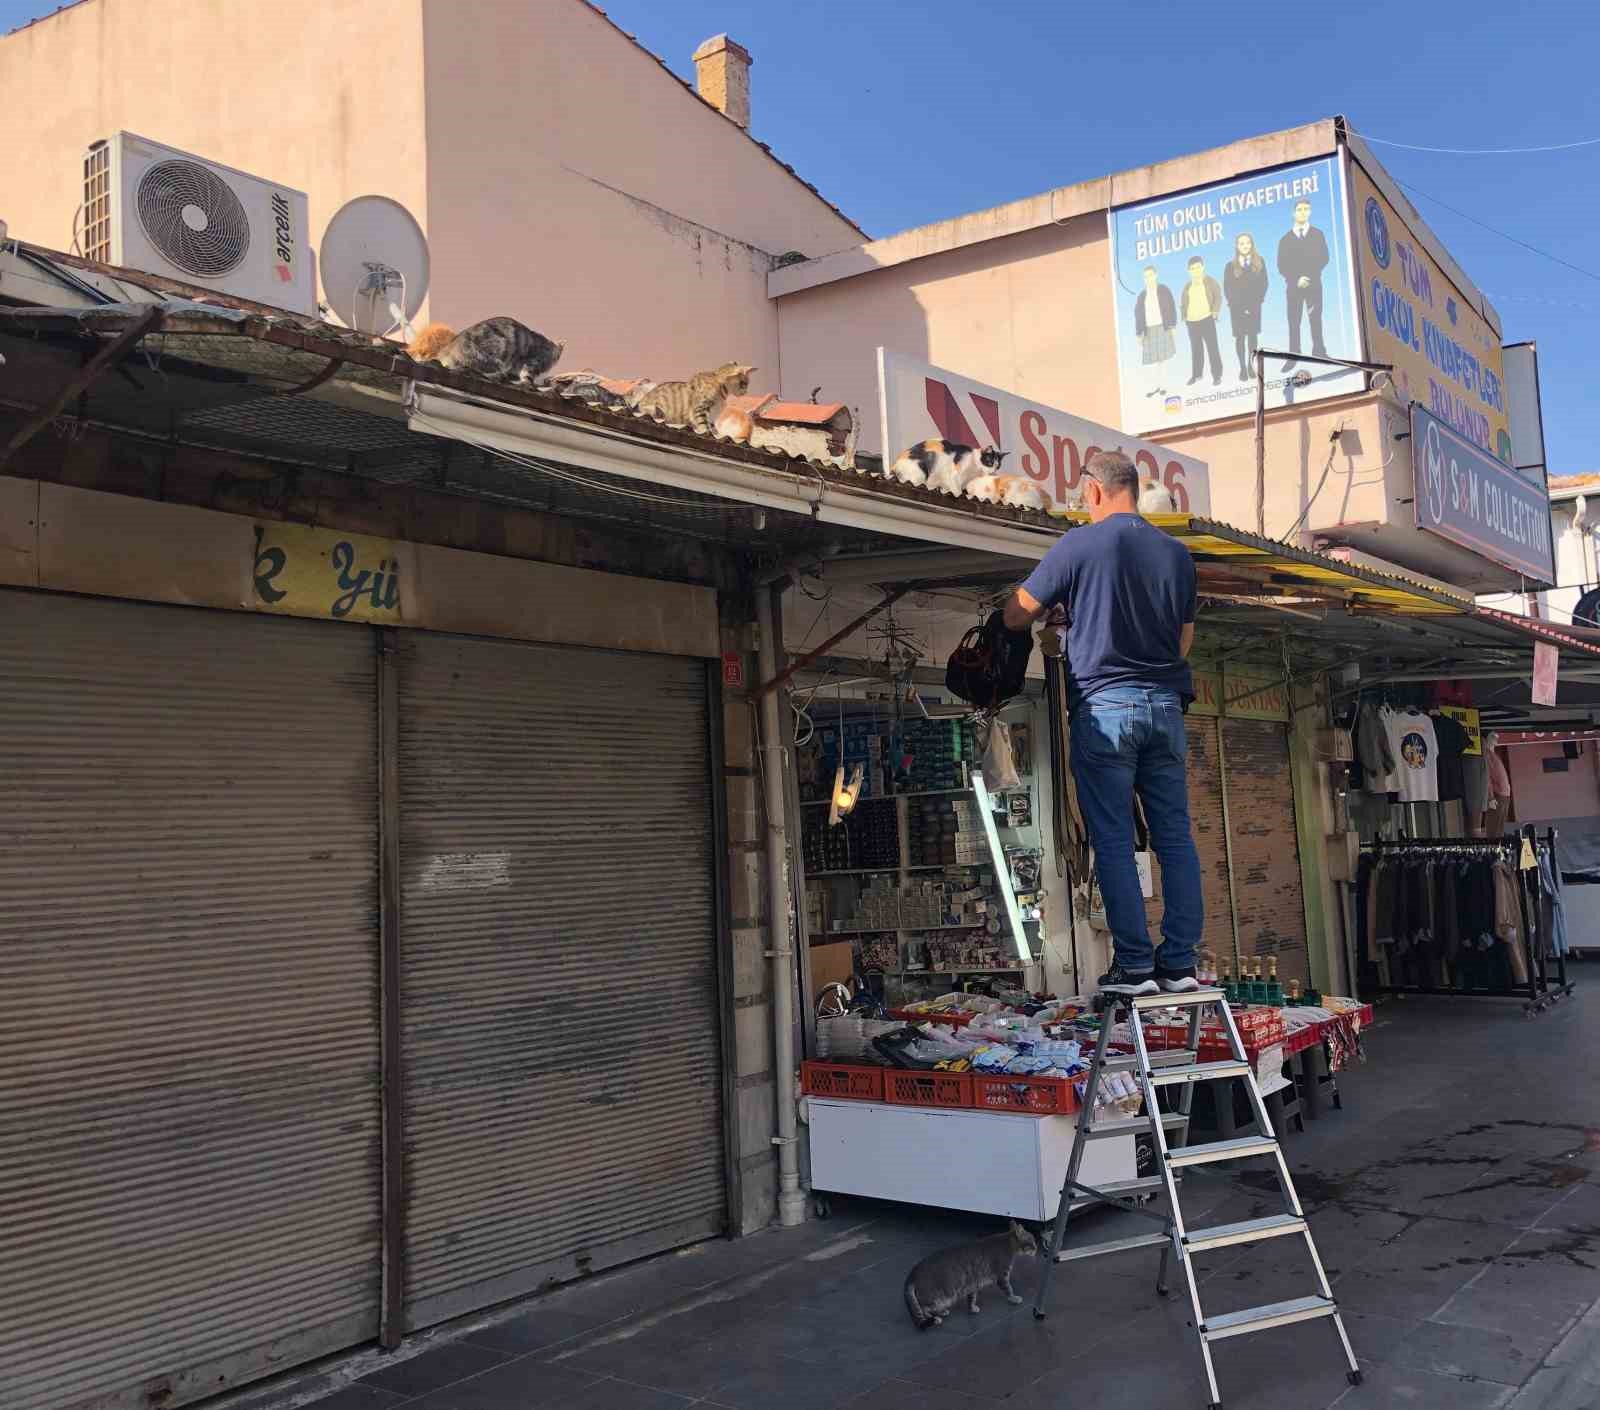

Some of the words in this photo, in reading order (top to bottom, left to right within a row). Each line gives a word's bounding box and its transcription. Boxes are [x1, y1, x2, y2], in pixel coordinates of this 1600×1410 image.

[272, 192, 294, 264] arçelik
[1134, 215, 1168, 236] TÜM
[1173, 204, 1216, 227] OKUL
[1220, 170, 1320, 216] KIYAFETLERİ
[1136, 222, 1224, 261] BULUNUR
[1396, 241, 1433, 308] TÜM
[1372, 277, 1421, 352] OKUL
[1451, 459, 1480, 522] S&M
[1484, 479, 1550, 560] COLLECTION
